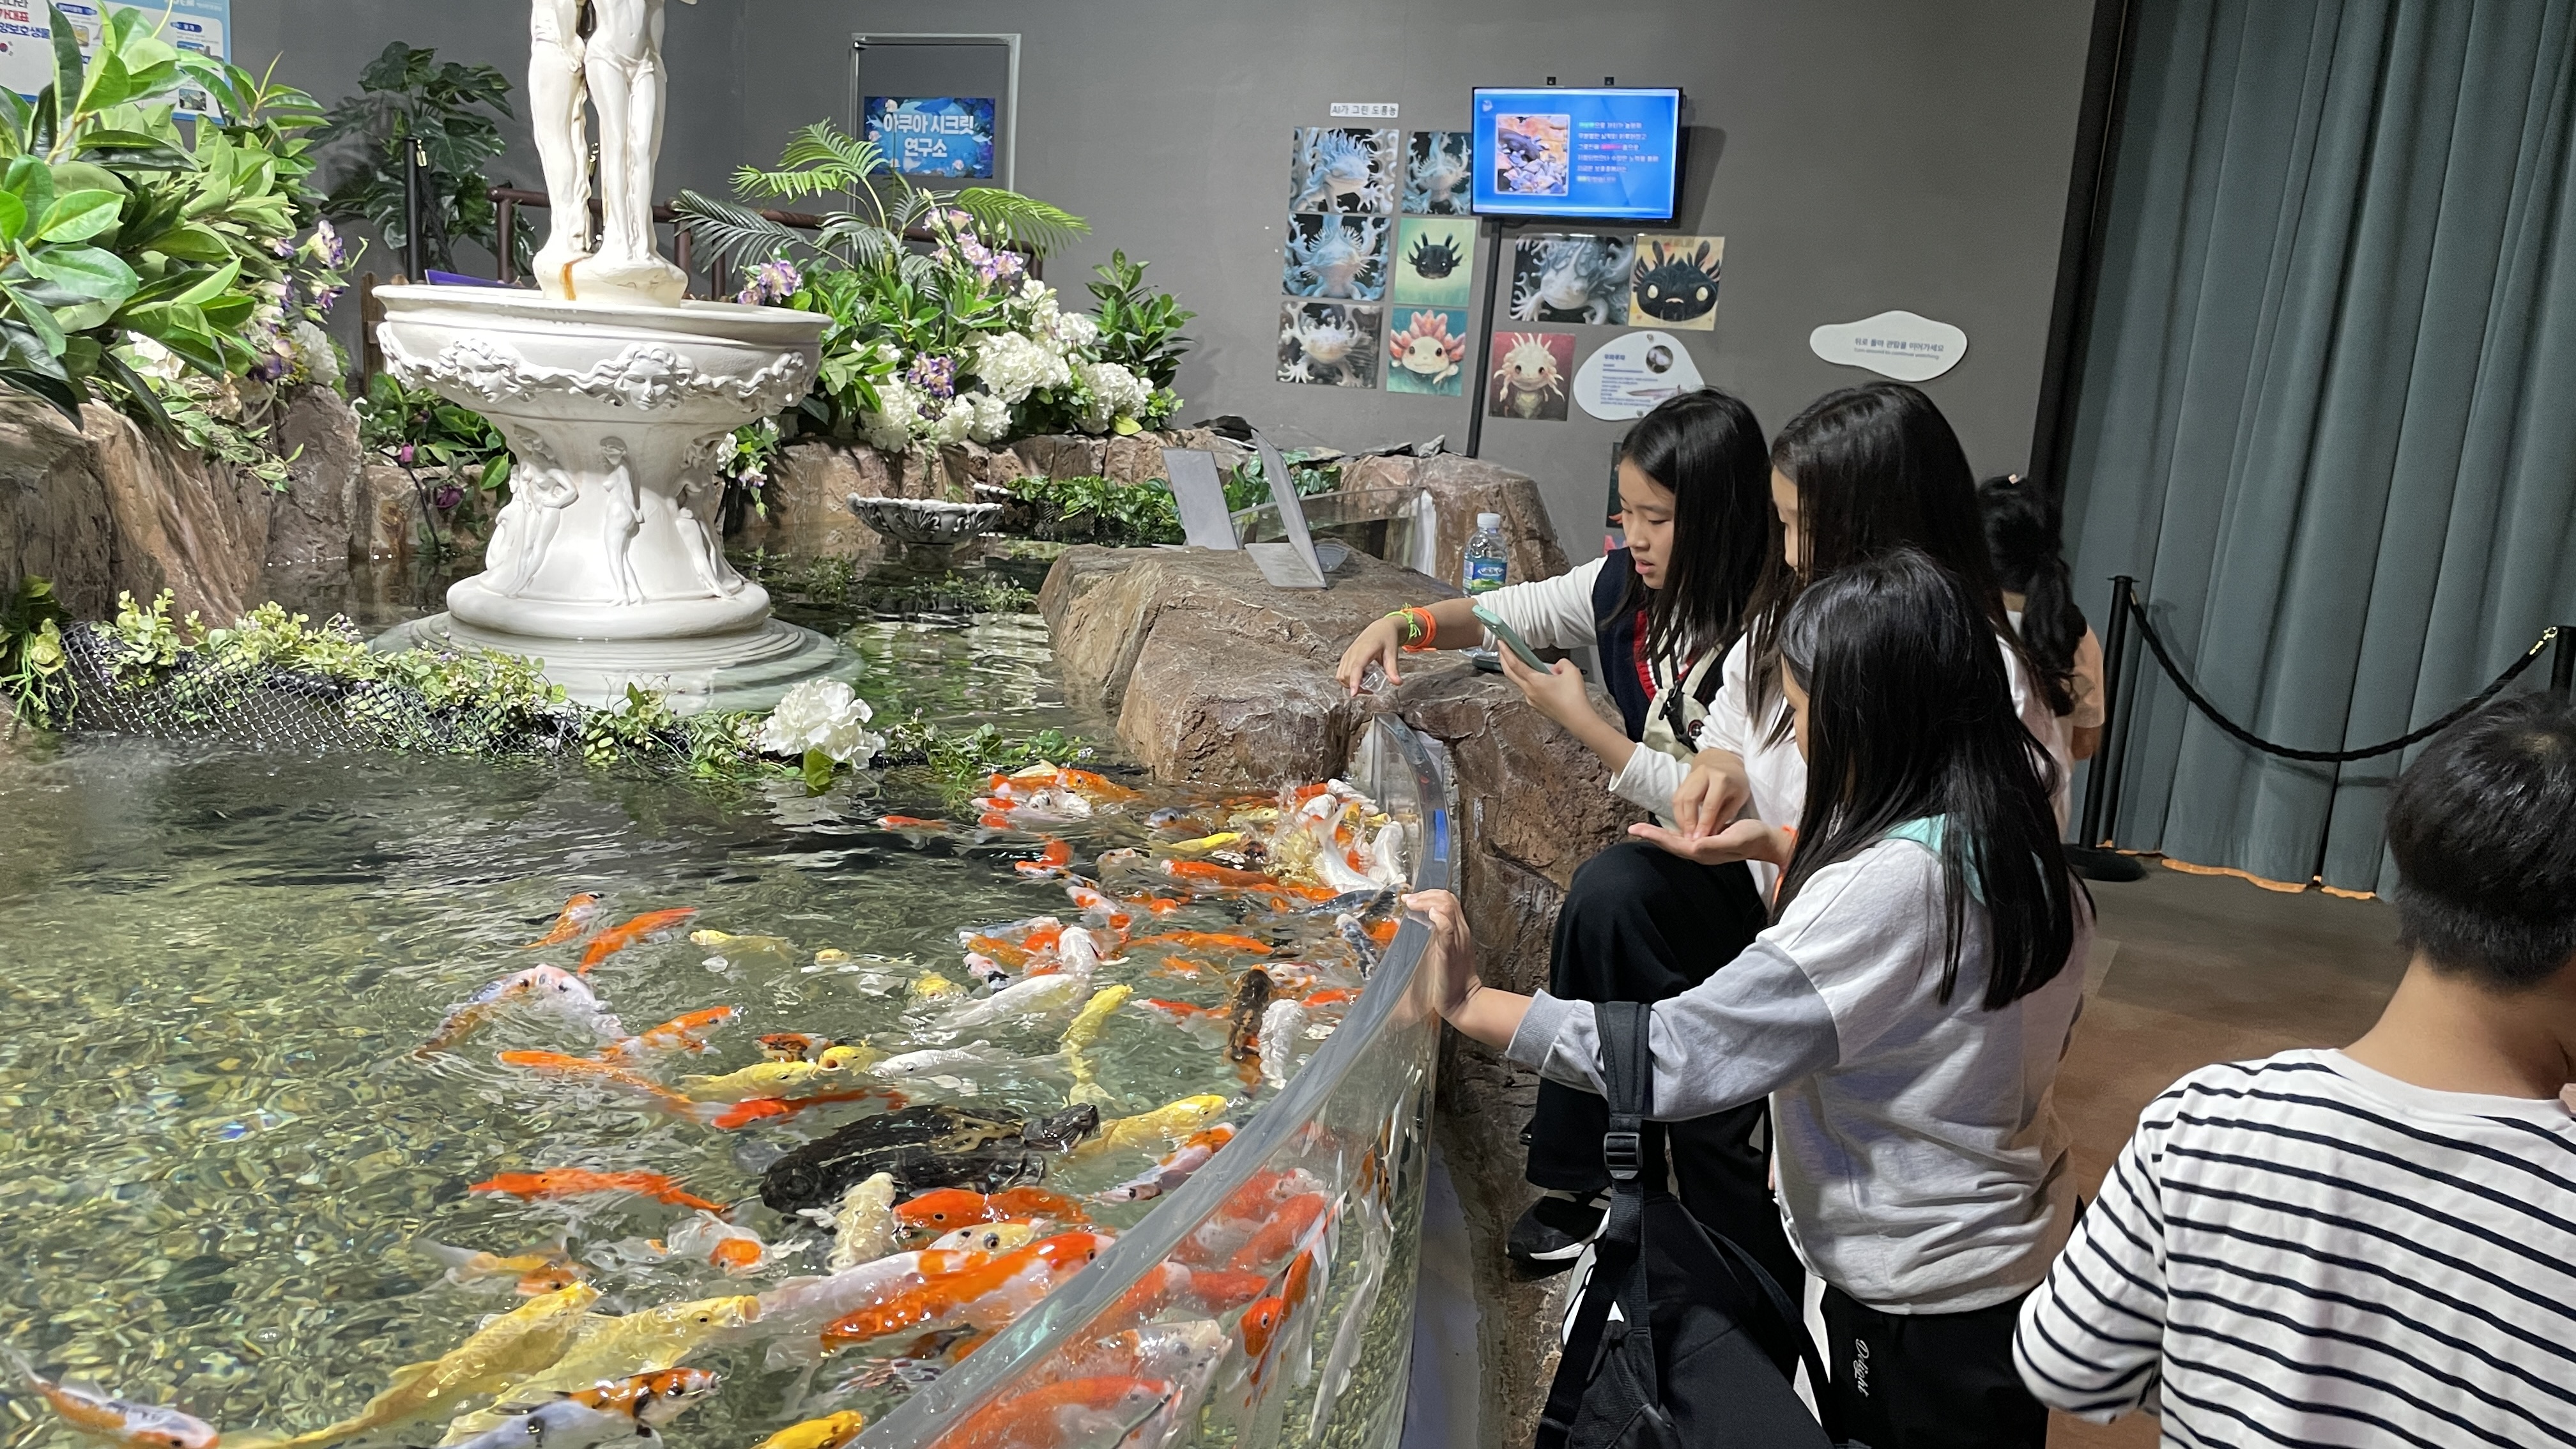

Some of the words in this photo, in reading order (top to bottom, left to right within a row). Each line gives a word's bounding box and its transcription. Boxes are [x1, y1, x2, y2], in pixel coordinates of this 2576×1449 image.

[1352, 105, 1368, 115] 그린
[883, 114, 928, 133] 아쿠아
[931, 116, 974, 134] 시크릿
[905, 138, 947, 157] 연구소
[1853, 1338, 1869, 1397] Delight
